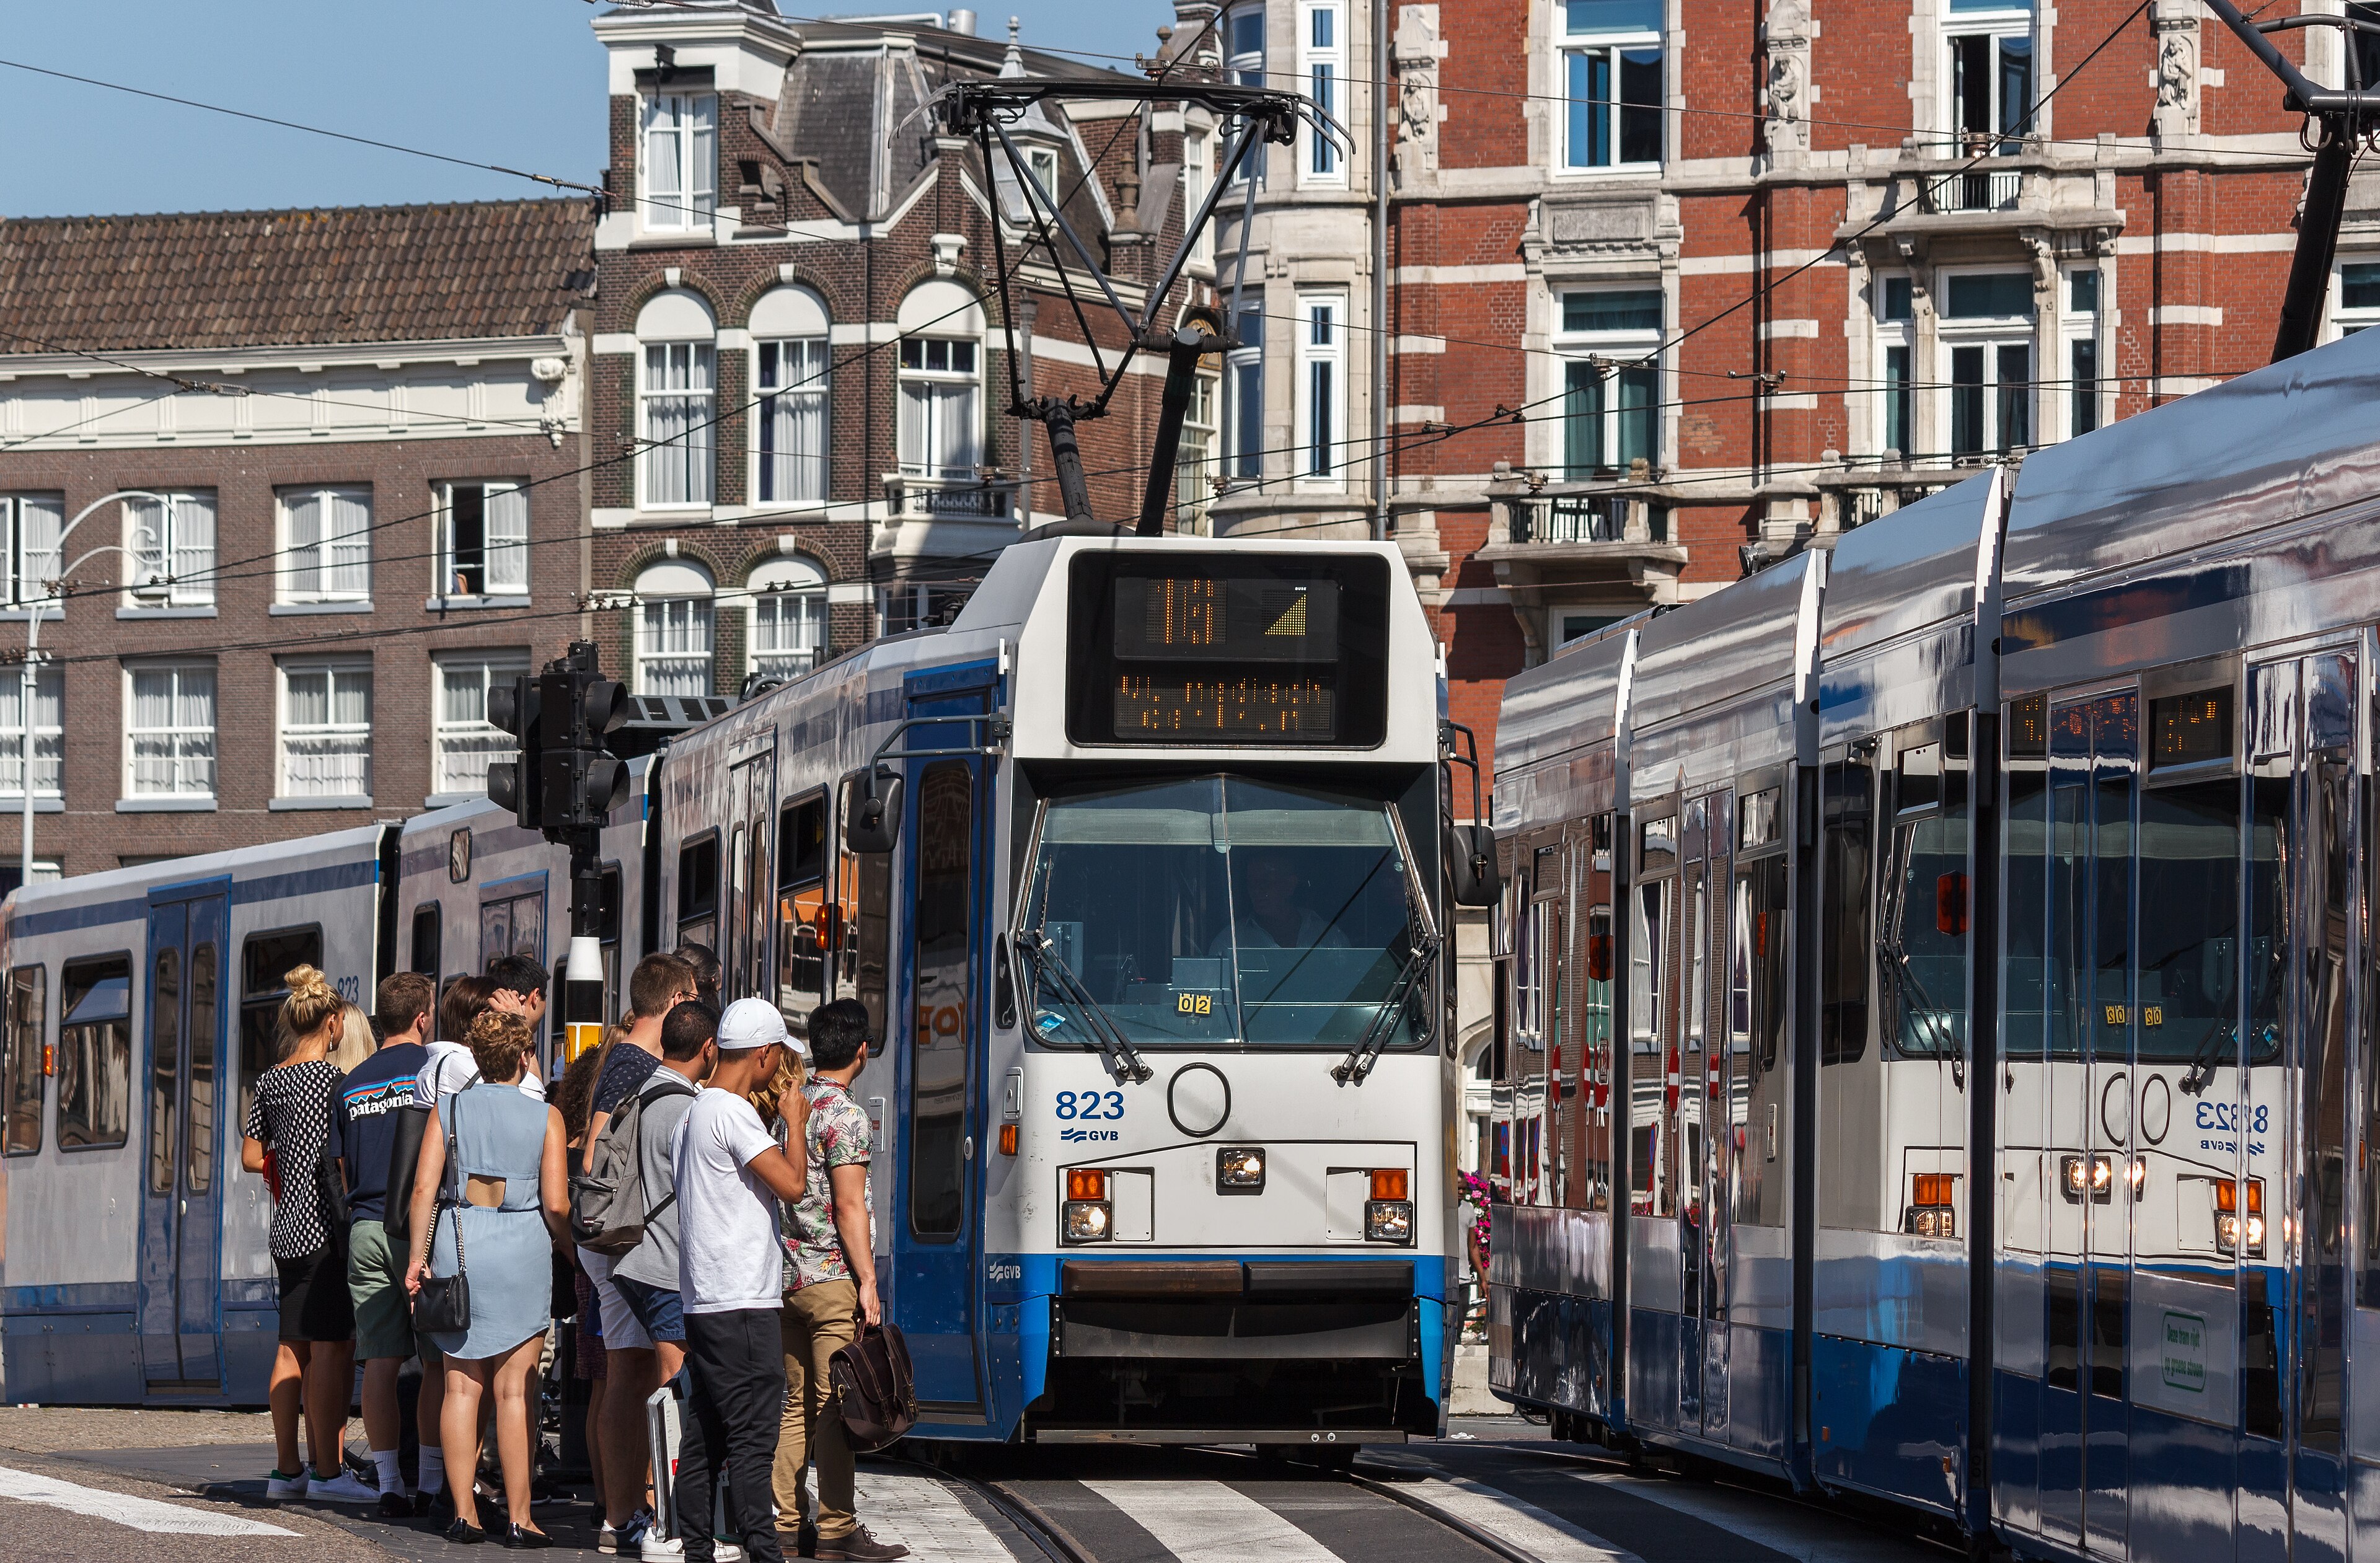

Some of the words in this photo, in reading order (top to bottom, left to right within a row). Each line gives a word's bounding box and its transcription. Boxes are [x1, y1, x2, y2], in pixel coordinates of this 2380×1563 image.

[1181, 998, 1207, 1012] 02
[349, 1092, 413, 1121] patagonia
[1056, 1091, 1124, 1119] 823
[1089, 1130, 1118, 1140] GVB
[1004, 1266, 1021, 1279] GVB
